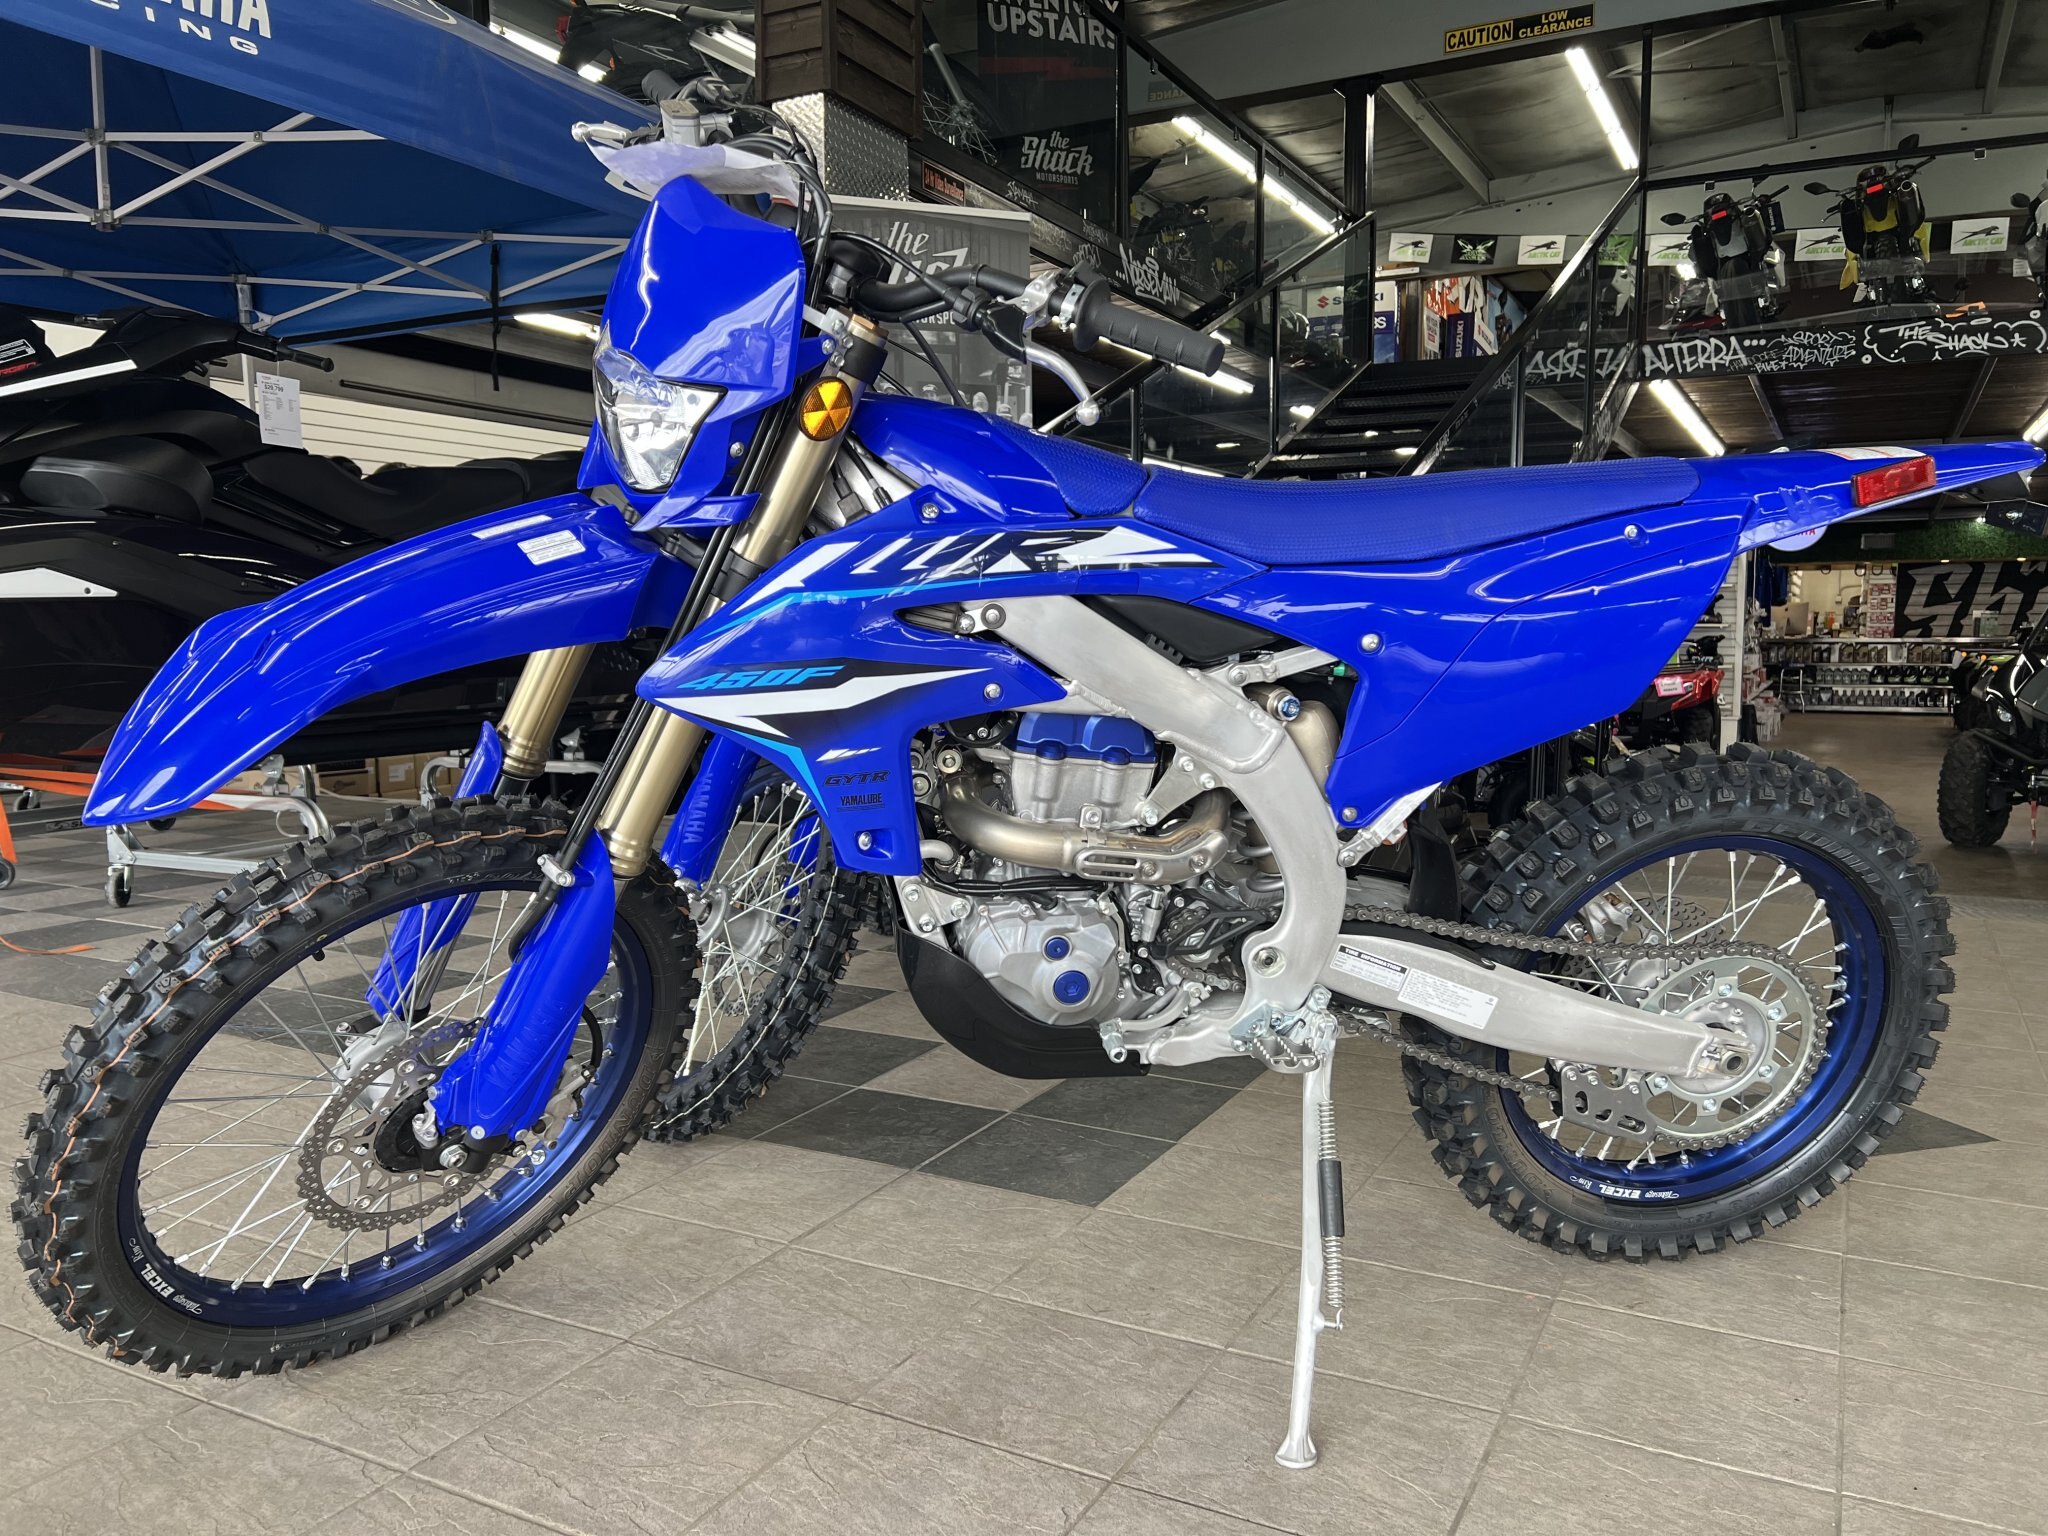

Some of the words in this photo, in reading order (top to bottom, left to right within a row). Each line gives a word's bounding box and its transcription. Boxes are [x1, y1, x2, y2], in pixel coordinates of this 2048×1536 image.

[1541, 10, 1568, 23] LOW
[1447, 21, 1512, 49] CAUTION
[1518, 16, 1591, 38] CLEARANCE
[1050, 130, 1070, 149] the
[1021, 135, 1094, 176] Shack
[1036, 172, 1079, 185] MOTORSPORTS
[888, 221, 929, 256] the
[1990, 237, 2005, 246] CAT
[1455, 320, 1464, 358] SUZUKI
[1792, 331, 1843, 347] SPORT
[1878, 320, 1932, 340] THE
[1926, 332, 2009, 351] SHACK
[676, 665, 847, 690] 450F
[824, 770, 891, 787] GYTR
[683, 773, 714, 844] YAMAHA
[840, 793, 883, 806] YAMALUBE
[1345, 948, 1360, 958] TIRE
[1360, 953, 1402, 973] INFORMATION
[1599, 1184, 1641, 1199] EXCEL
[141, 1263, 175, 1298] EXCEL
